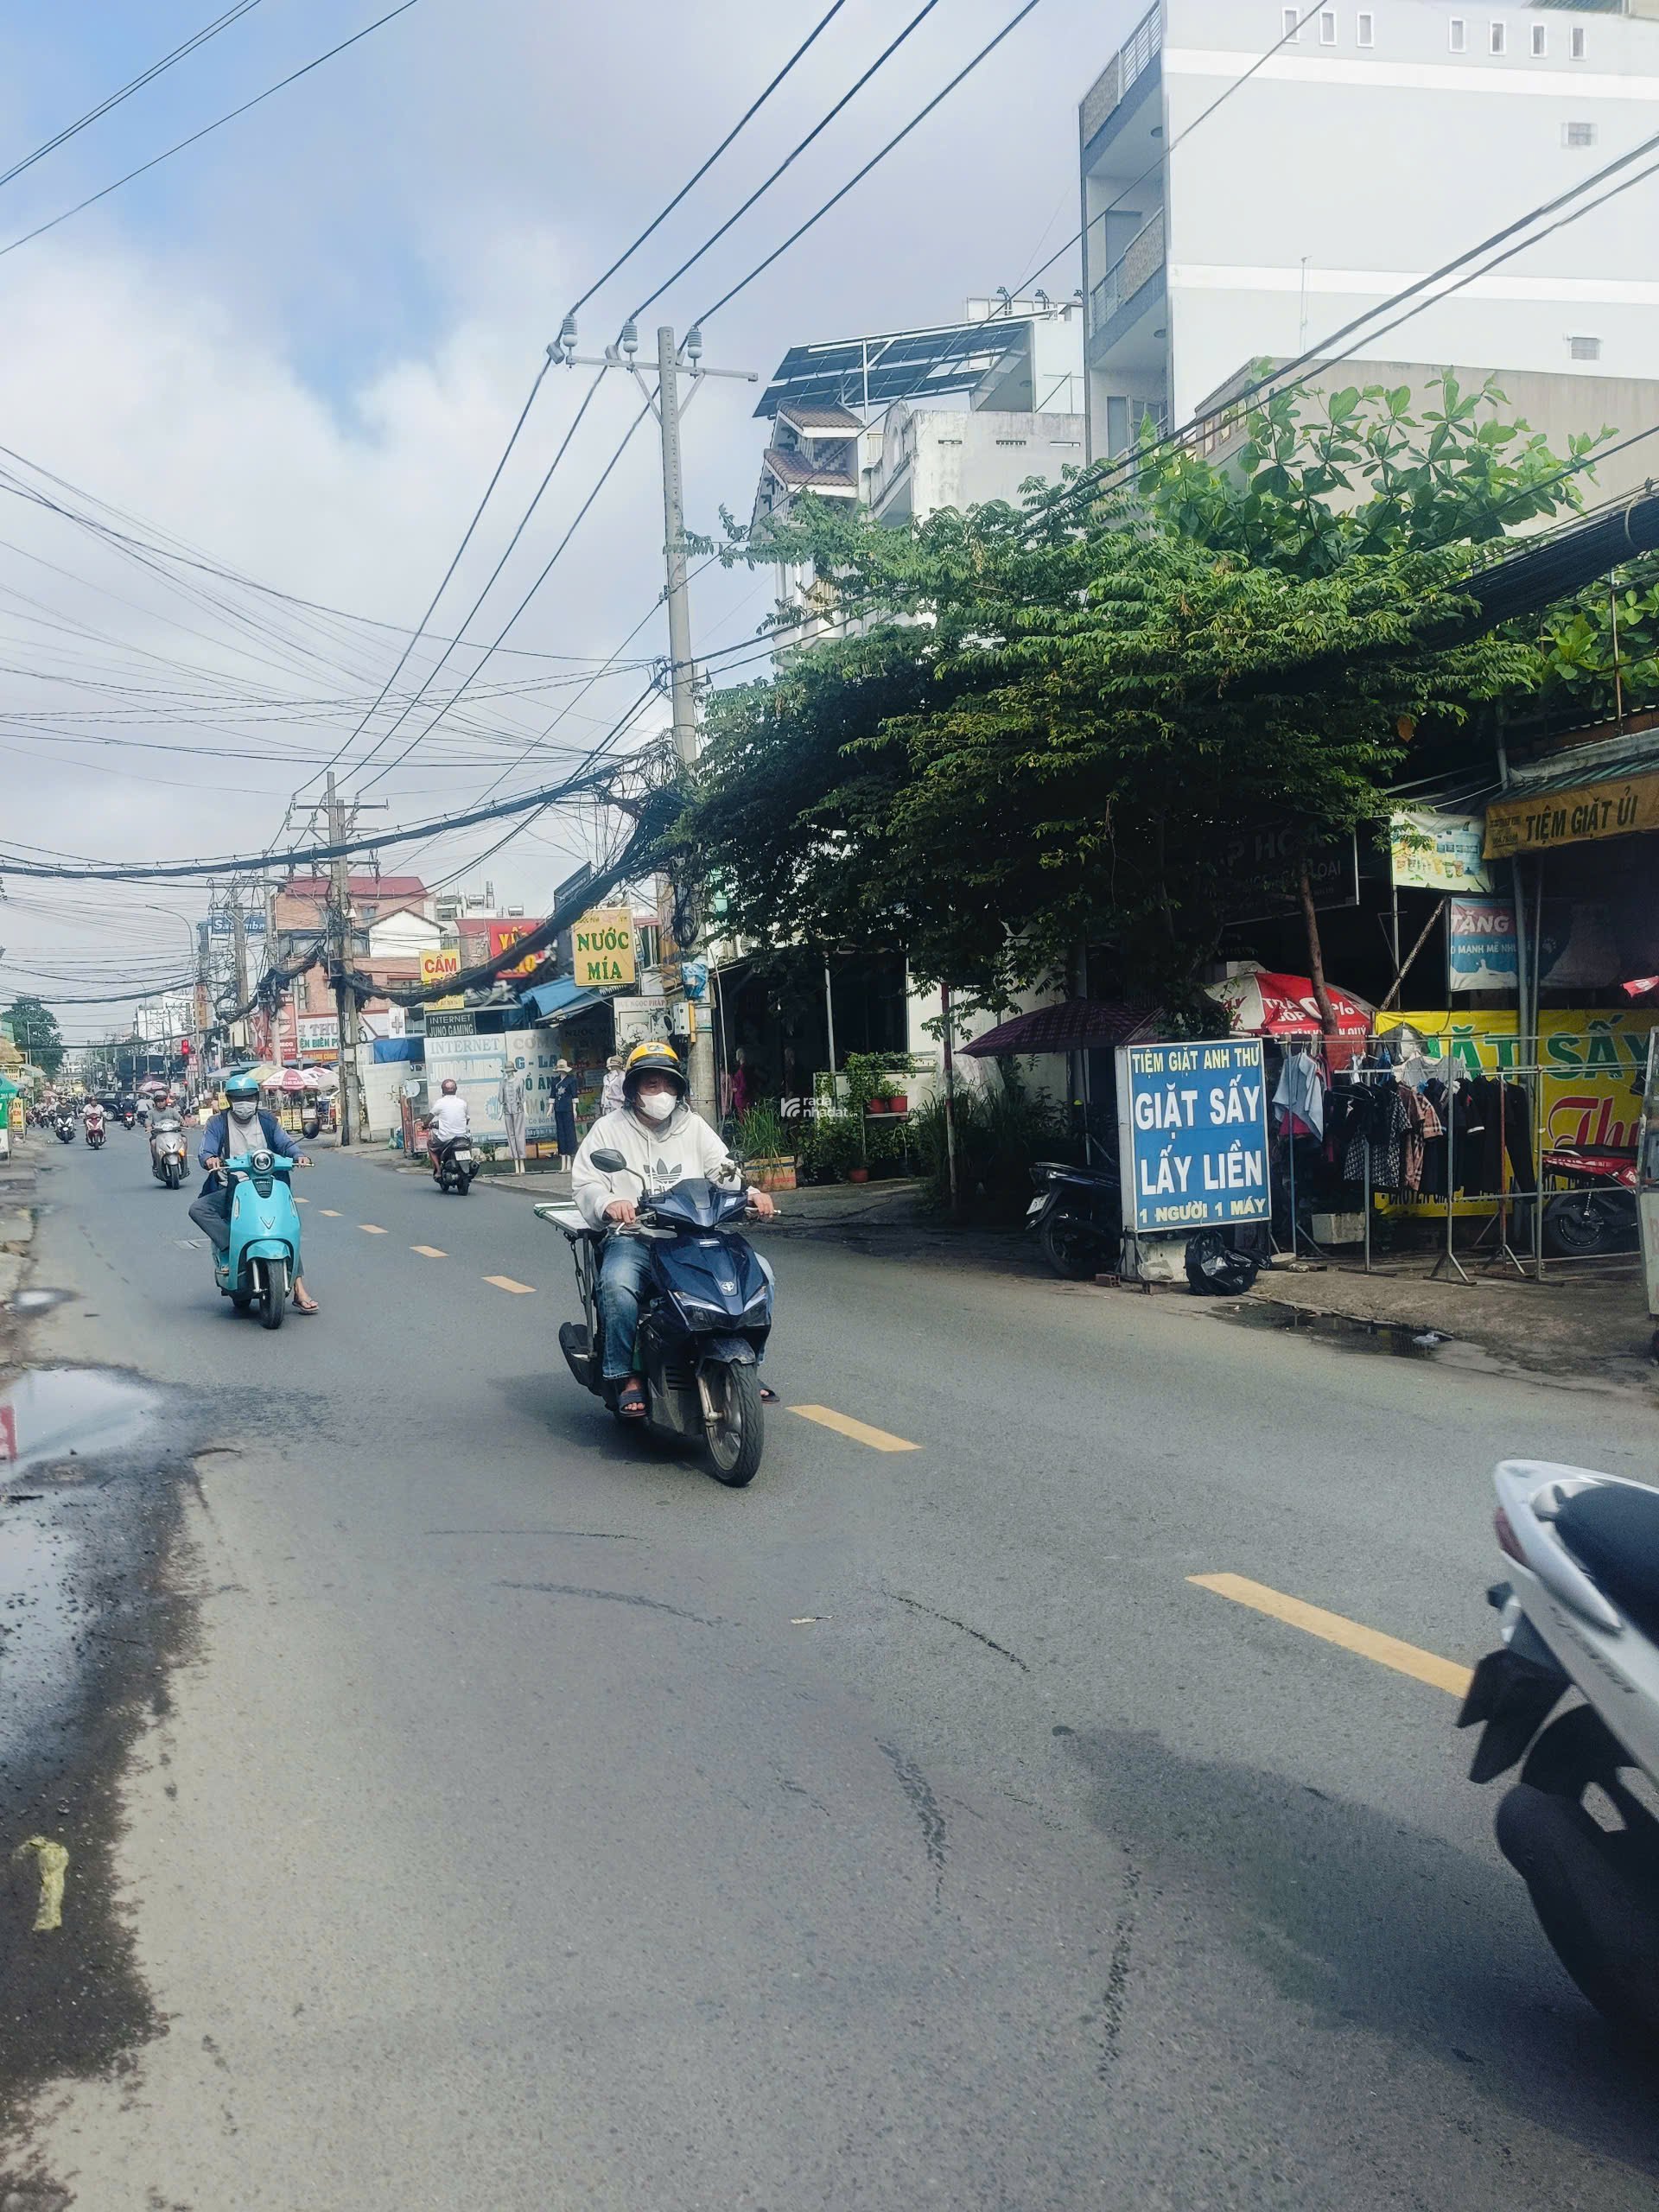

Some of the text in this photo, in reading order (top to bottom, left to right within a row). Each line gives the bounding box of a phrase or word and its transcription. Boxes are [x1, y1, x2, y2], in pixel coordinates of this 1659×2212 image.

[1526, 804, 1567, 844] TIỆM
[1572, 797, 1612, 838] GIẶT
[1617, 785, 1638, 826] ỦI
[576, 926, 629, 951] NƯỚC
[1459, 944, 1484, 955] MẠNH
[1487, 941, 1499, 953] MẼ
[424, 954, 457, 973] CẦM
[588, 956, 622, 981] MÍA
[429, 1014, 471, 1025] INTERNET
[429, 1024, 474, 1037] JUNO GAMING
[429, 1038, 499, 1054] INTERNET
[1132, 1043, 1260, 1079] TIỆM GIẶT ANH THƯ
[1135, 1074, 1260, 1140] GIẶT SẤY
[1141, 1140, 1263, 1196] LẤY LIỀN
[1139, 1196, 1267, 1224] 1 NGƯỜI 1 MÁY
